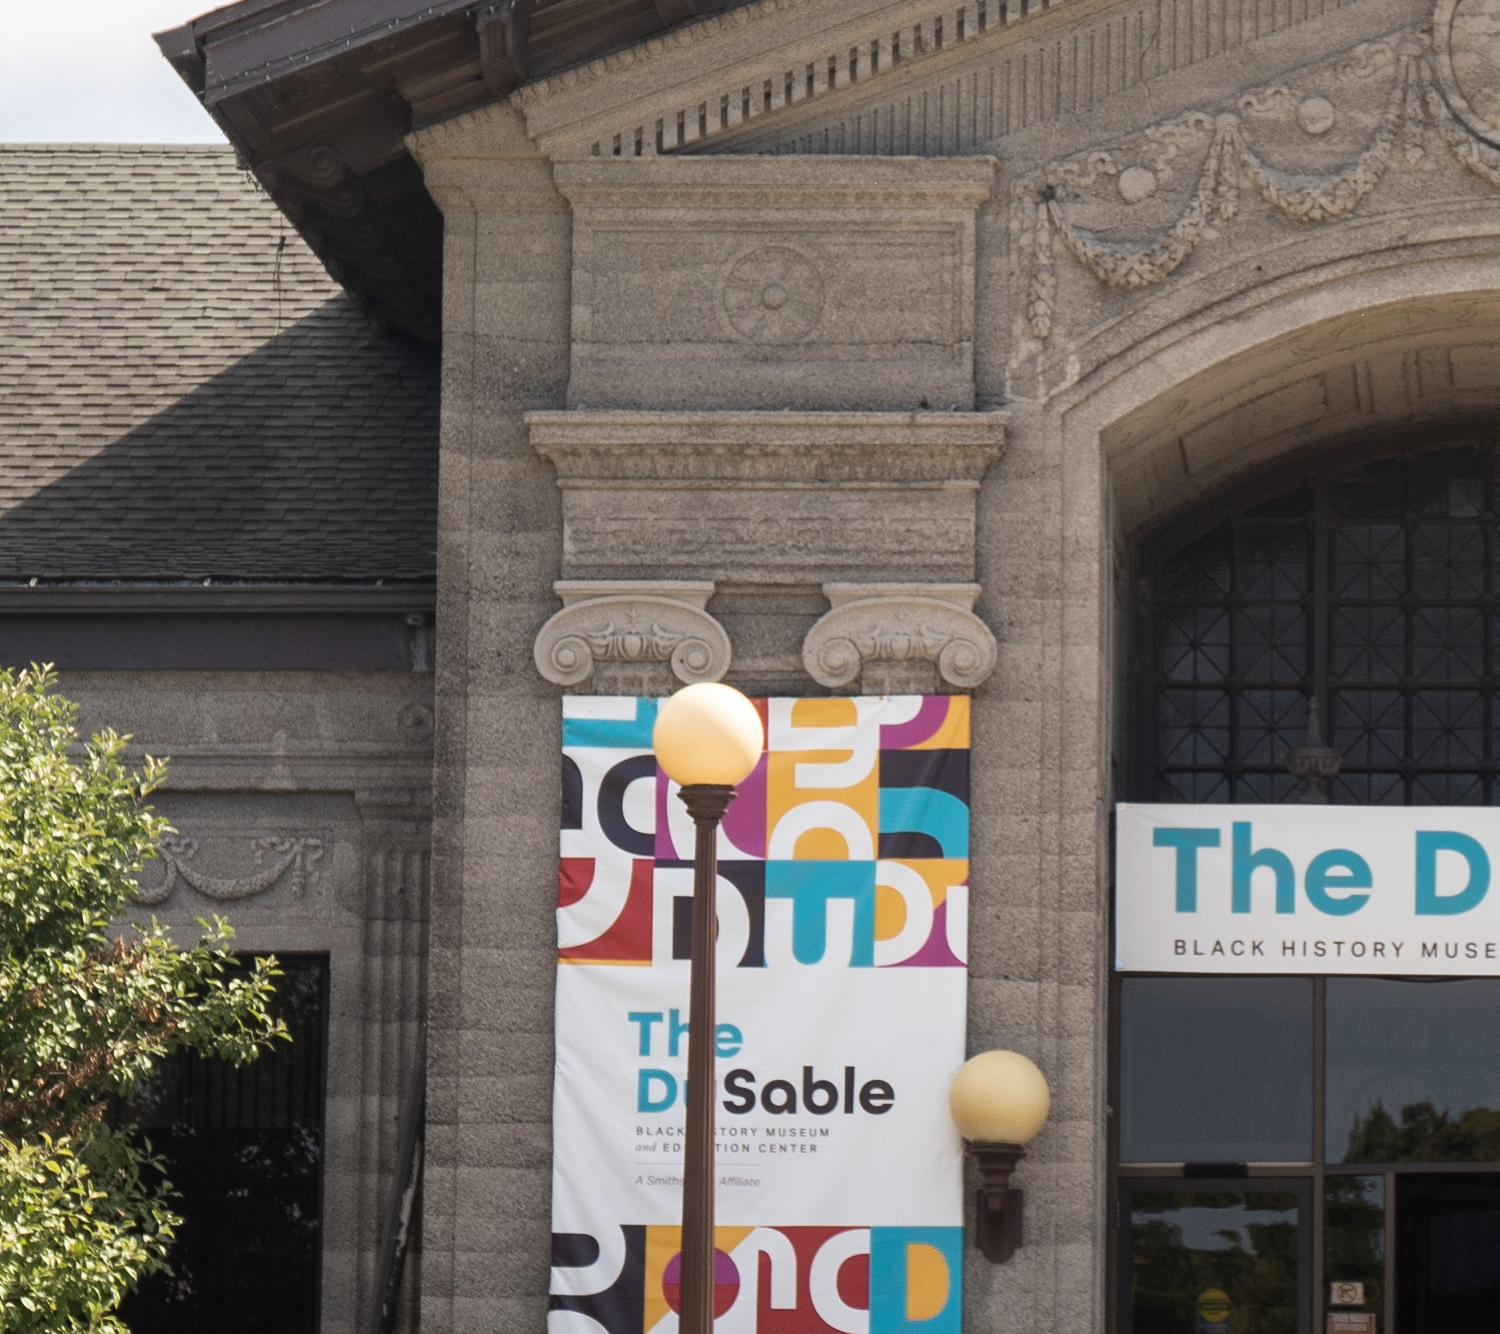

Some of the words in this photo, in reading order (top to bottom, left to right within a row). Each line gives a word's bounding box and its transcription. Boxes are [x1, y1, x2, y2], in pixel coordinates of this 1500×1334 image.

[1152, 820, 1373, 916] The
[1173, 939, 1266, 956] BLACK
[1281, 940, 1405, 958] HISTORY
[628, 1008, 743, 1058] The
[637, 1065, 896, 1116] DSable
[636, 1126, 684, 1137] BLACK
[766, 1127, 830, 1138] MUSEUM
[635, 1142, 658, 1153] and
[663, 1143, 751, 1154] EDTION
[758, 1143, 818, 1154] CENTER
[635, 1175, 644, 1186] A
[646, 1175, 684, 1187] Smiths
[718, 1176, 761, 1188] Affiliate
